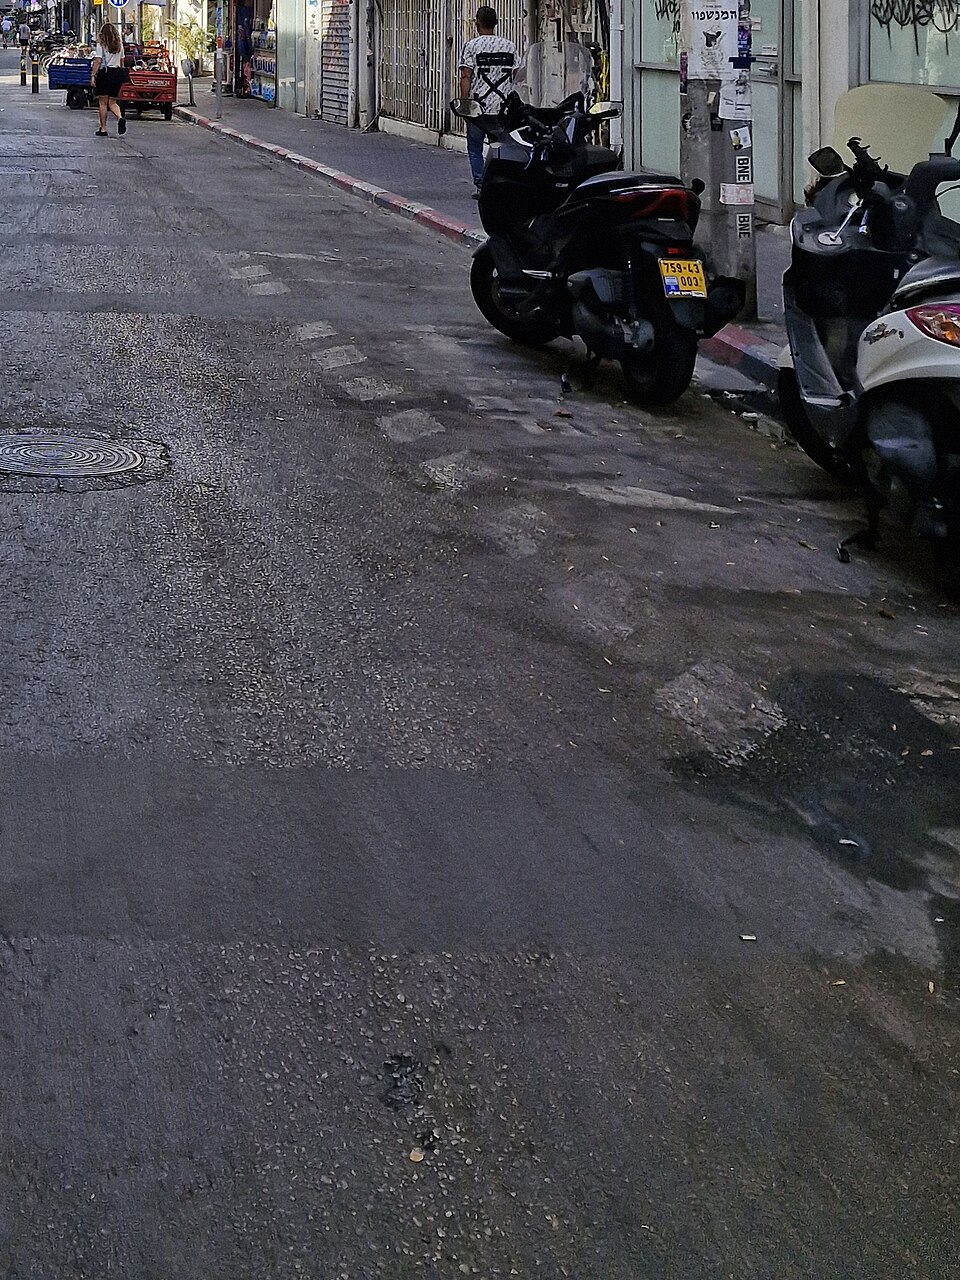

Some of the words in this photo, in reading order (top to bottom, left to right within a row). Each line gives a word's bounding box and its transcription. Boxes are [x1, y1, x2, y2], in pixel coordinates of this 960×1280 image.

[737, 157, 750, 182] BNE
[738, 215, 751, 239] BNE
[663, 262, 700, 274] 759-43
[680, 276, 699, 287] 003
